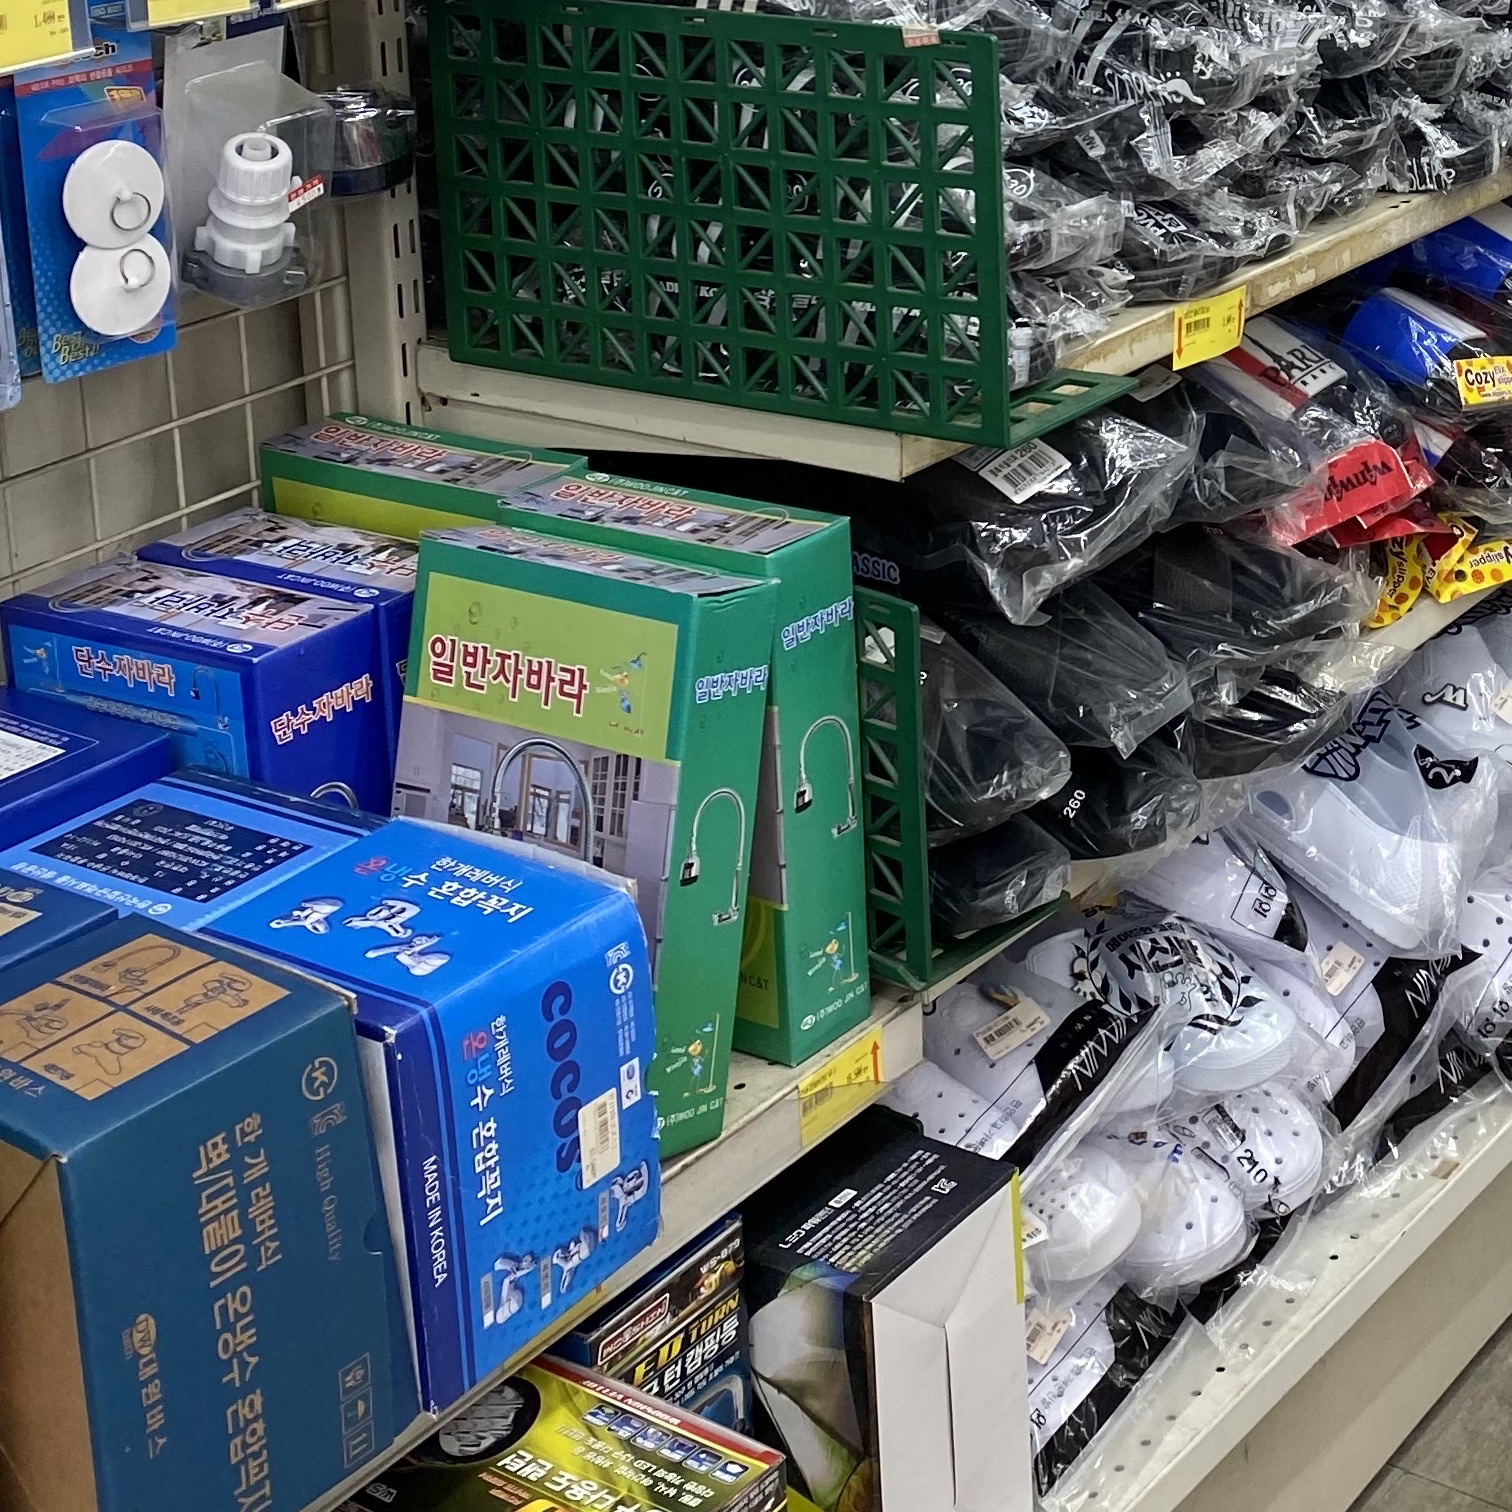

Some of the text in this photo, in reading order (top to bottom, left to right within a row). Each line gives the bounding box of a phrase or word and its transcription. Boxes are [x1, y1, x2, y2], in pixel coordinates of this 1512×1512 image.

[1464, 368, 1496, 387] Cozy
[309, 424, 449, 464] 일반자바라
[1016, 441, 1038, 459] 260
[549, 481, 704, 524] 일반자바라
[1387, 560, 1408, 599] slipper
[1468, 552, 1505, 569] slipper
[140, 587, 304, 634] 단수자바라
[780, 595, 855, 652] 일반자바라
[72, 645, 176, 697] 단수자바라
[427, 632, 590, 718] 일반자바라
[694, 664, 769, 703] 일반자바라
[270, 674, 374, 745] 단수자바라
[1062, 788, 1087, 819] 260
[367, 854, 535, 925] 온냉수 혼합꼭지
[434, 854, 524, 895] 한개레버식
[489, 1013, 516, 1098] 한개레버식
[540, 979, 584, 1176] COCOS
[461, 1028, 505, 1227] 온냉수 혼합꼭지
[234, 1111, 284, 1272] 한 개 레버식
[1236, 1148, 1269, 1184] 210
[192, 1131, 250, 1288] 벽/대붙이
[313, 1144, 343, 1263] High Quality
[421, 1156, 449, 1288] MADE IN KOREA
[214, 1284, 260, 1387] 온냉수
[685, 1312, 741, 1375] 캠핑등
[687, 1288, 741, 1342] TURN
[138, 1351, 169, 1461] 대원바스
[496, 1449, 628, 1512] 랜턴 다용도
[634, 1458, 656, 1475] LED
